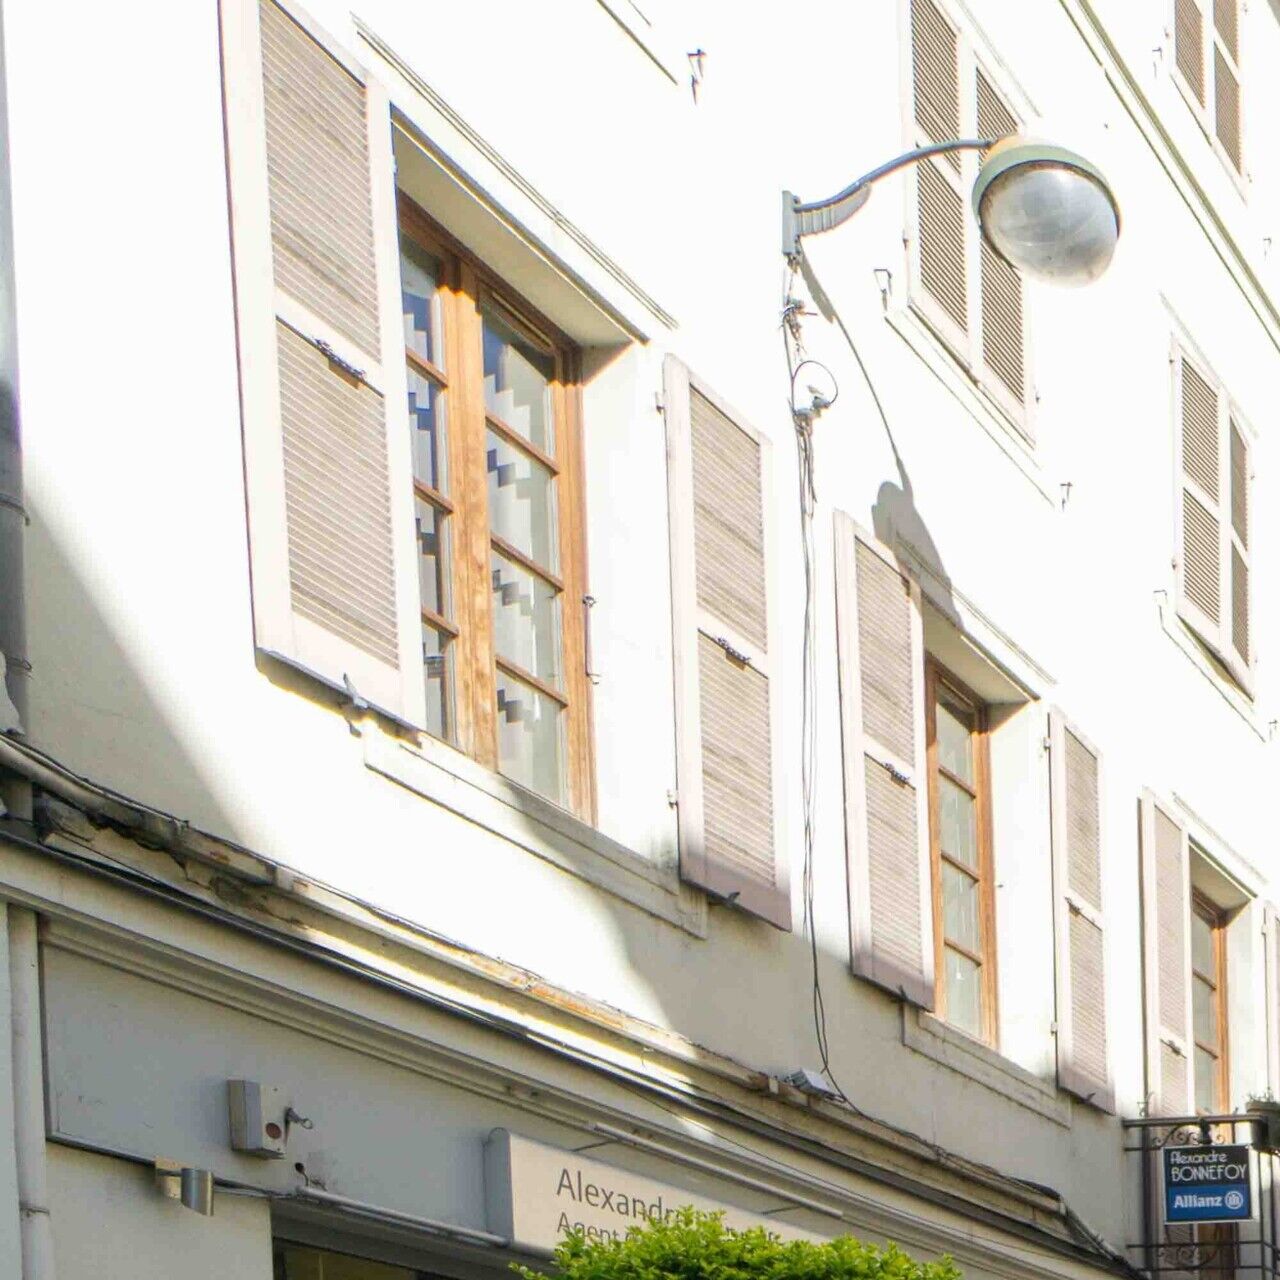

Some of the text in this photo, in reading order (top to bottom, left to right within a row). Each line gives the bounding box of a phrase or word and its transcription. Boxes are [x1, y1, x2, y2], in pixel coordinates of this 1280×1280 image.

[1170, 1151, 1227, 1165] Alexandre
[1171, 1164, 1247, 1181] BONNEFOY
[1174, 1194, 1222, 1208] Allianz
